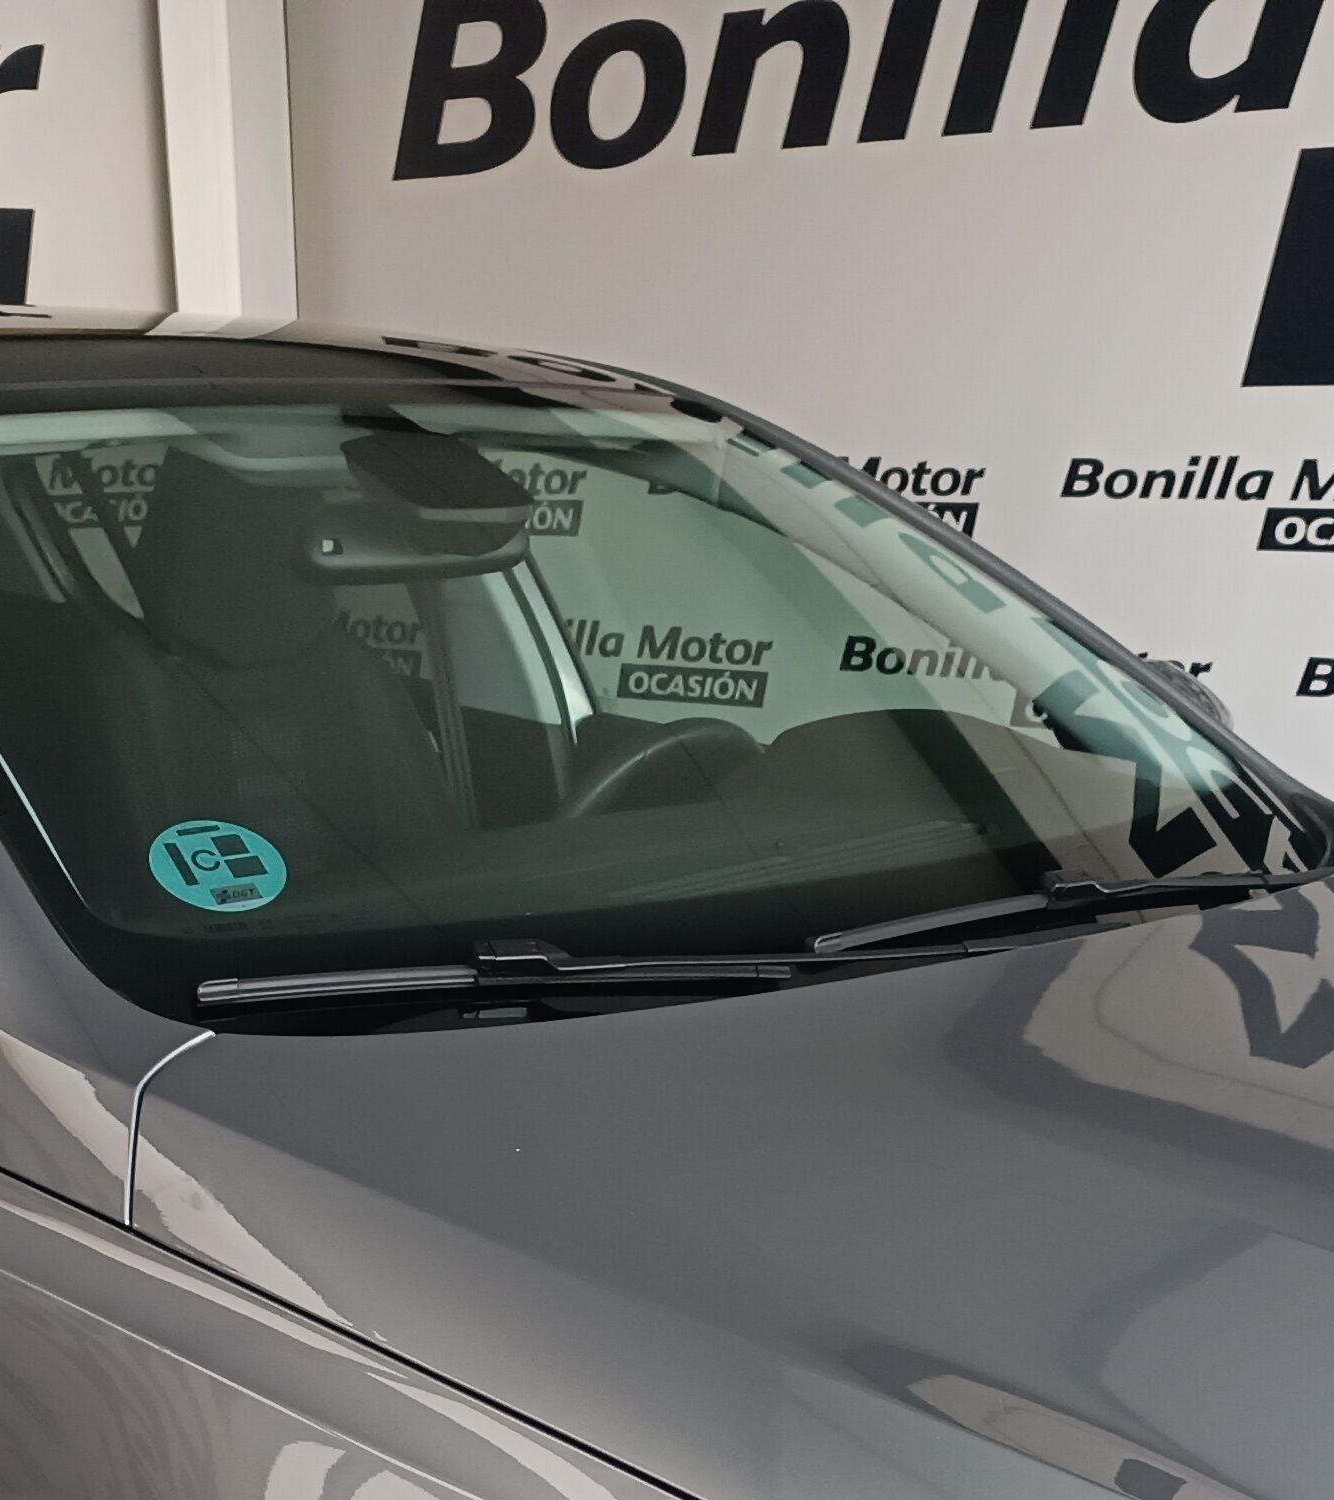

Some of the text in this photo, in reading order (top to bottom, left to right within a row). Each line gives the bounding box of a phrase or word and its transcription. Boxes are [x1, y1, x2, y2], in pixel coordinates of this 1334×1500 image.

[393, 0, 1320, 180] Bonilla
[496, 461, 587, 497] otor
[1062, 456, 1271, 502] Bonilla
[636, 624, 774, 667] Motor
[628, 671, 759, 701] OCASIÓN
[191, 849, 221, 872] C
